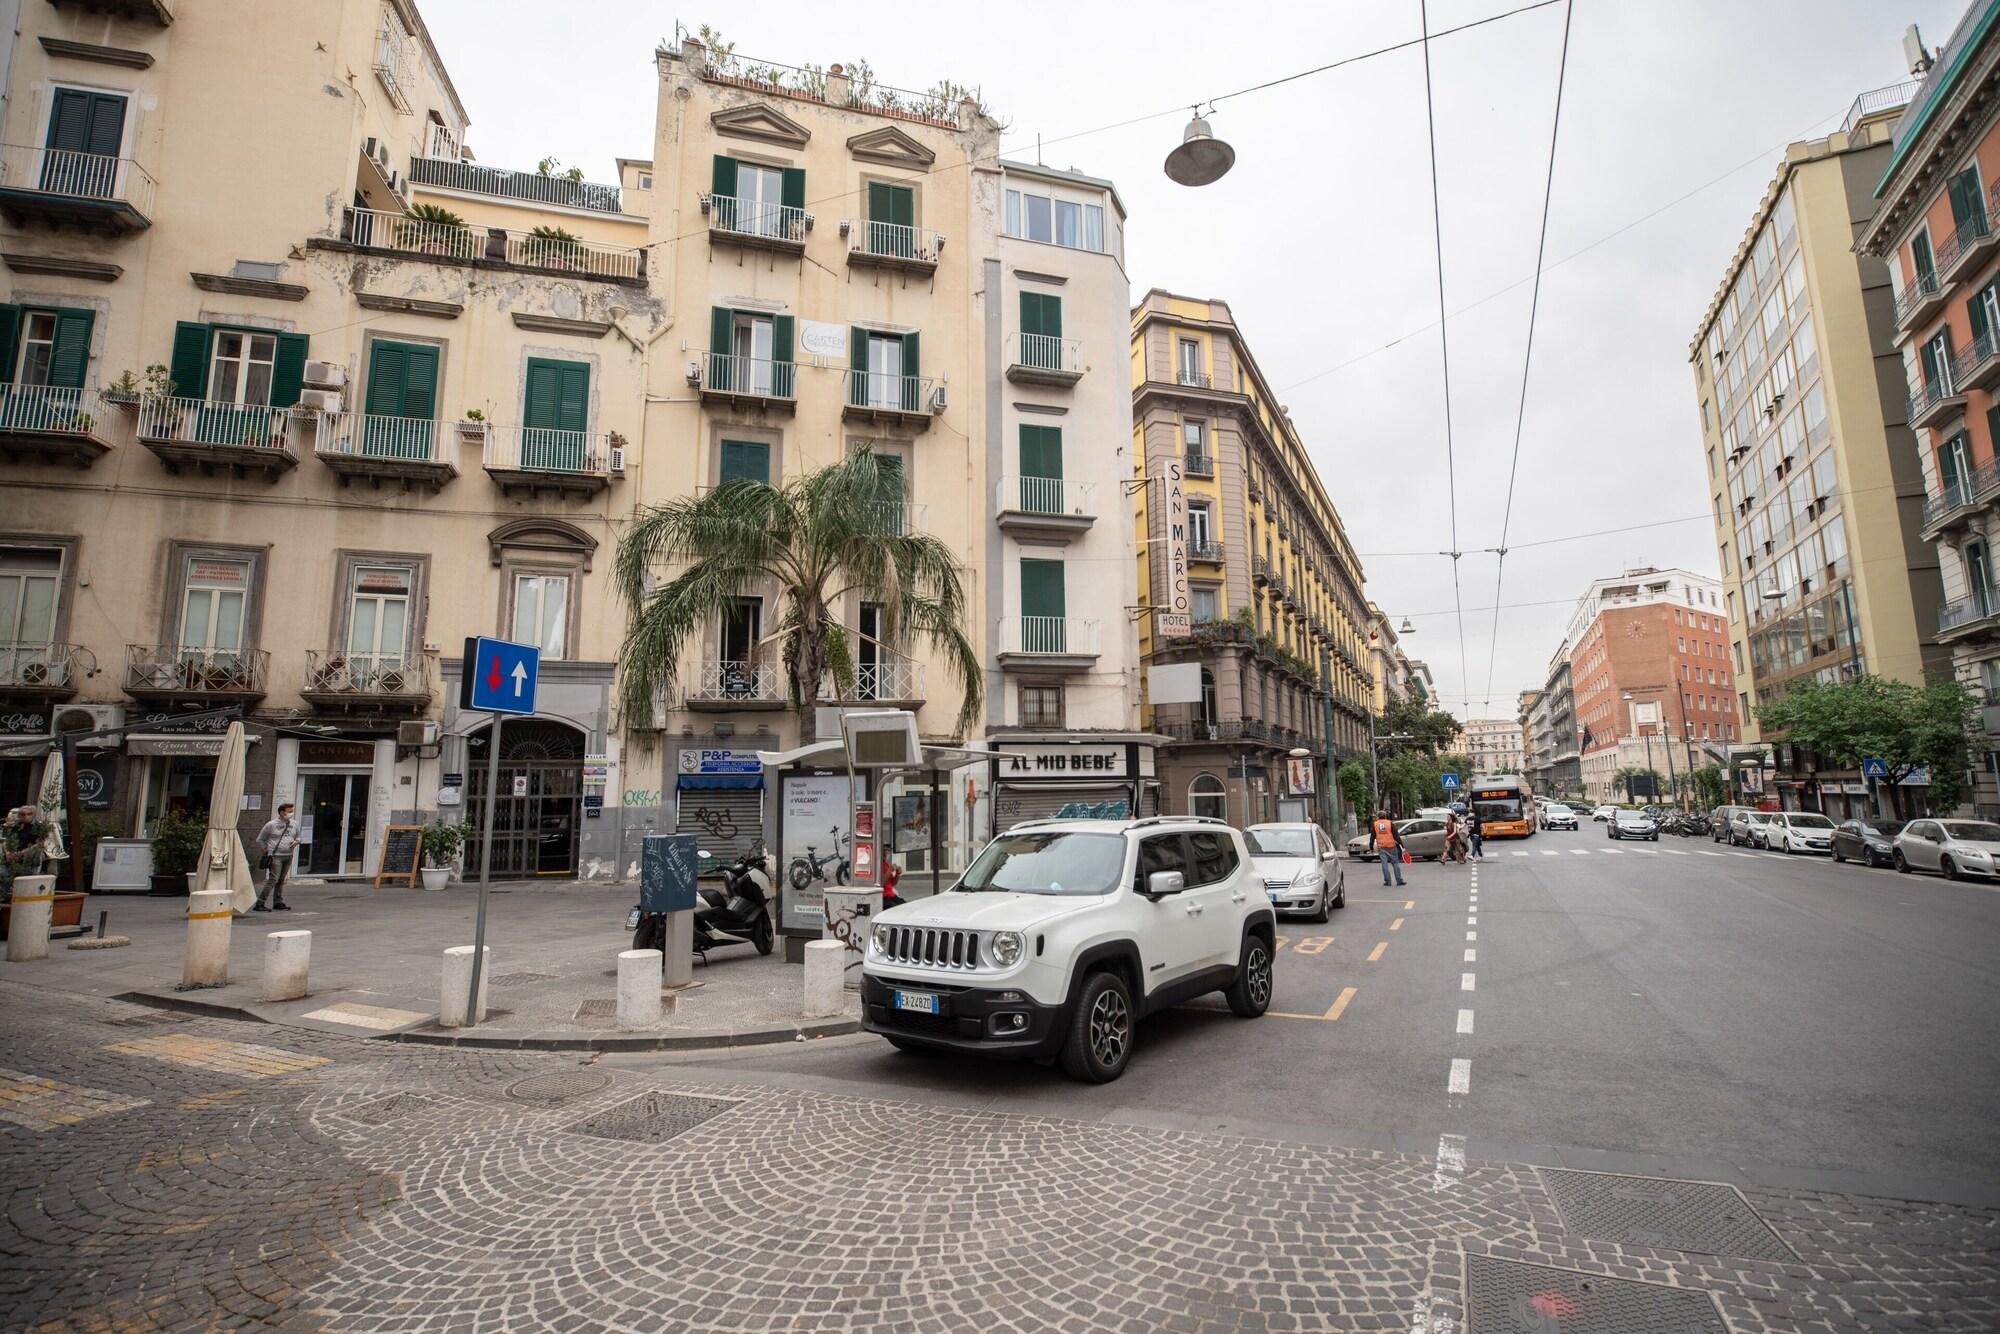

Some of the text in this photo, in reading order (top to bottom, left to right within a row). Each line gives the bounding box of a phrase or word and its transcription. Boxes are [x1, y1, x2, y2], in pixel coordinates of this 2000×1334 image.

[1170, 464, 1188, 610] SAN MARCO
[1162, 615, 1189, 626] HOTEL
[310, 744, 365, 755] CANTINA
[701, 750, 732, 761] P&P
[1010, 756, 1031, 770] AL
[1037, 755, 1067, 770] MIO
